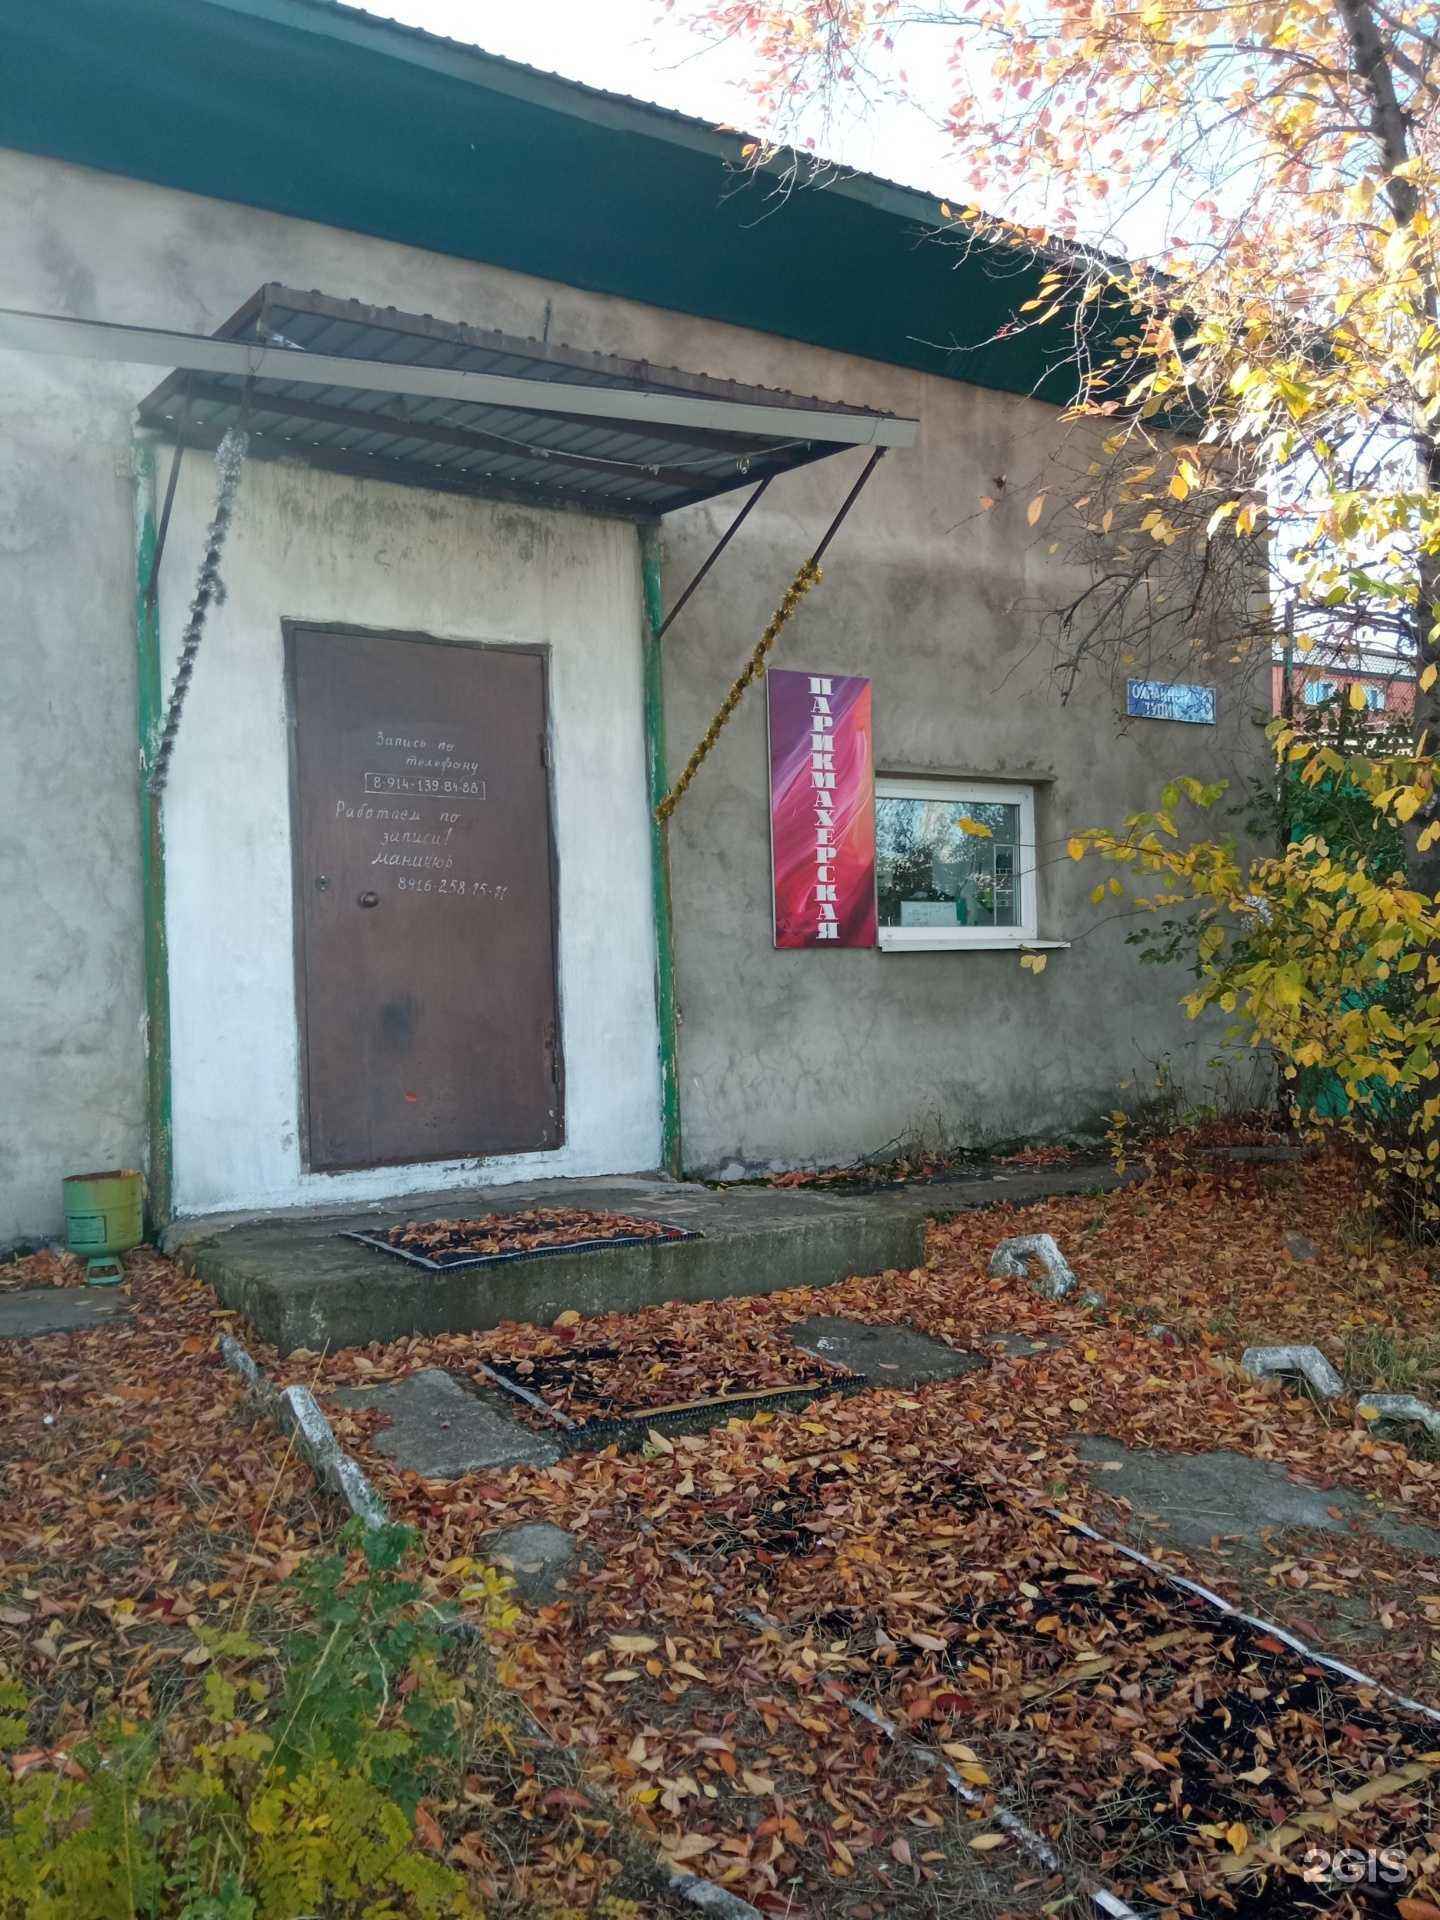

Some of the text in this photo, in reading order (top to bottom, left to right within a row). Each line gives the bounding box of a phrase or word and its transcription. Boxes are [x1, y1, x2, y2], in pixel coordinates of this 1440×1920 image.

[376, 731, 456, 752] Запись по
[335, 799, 461, 824] Работаем по
[807, 676, 841, 940] ПАРИКМАХЕРСКАЯ
